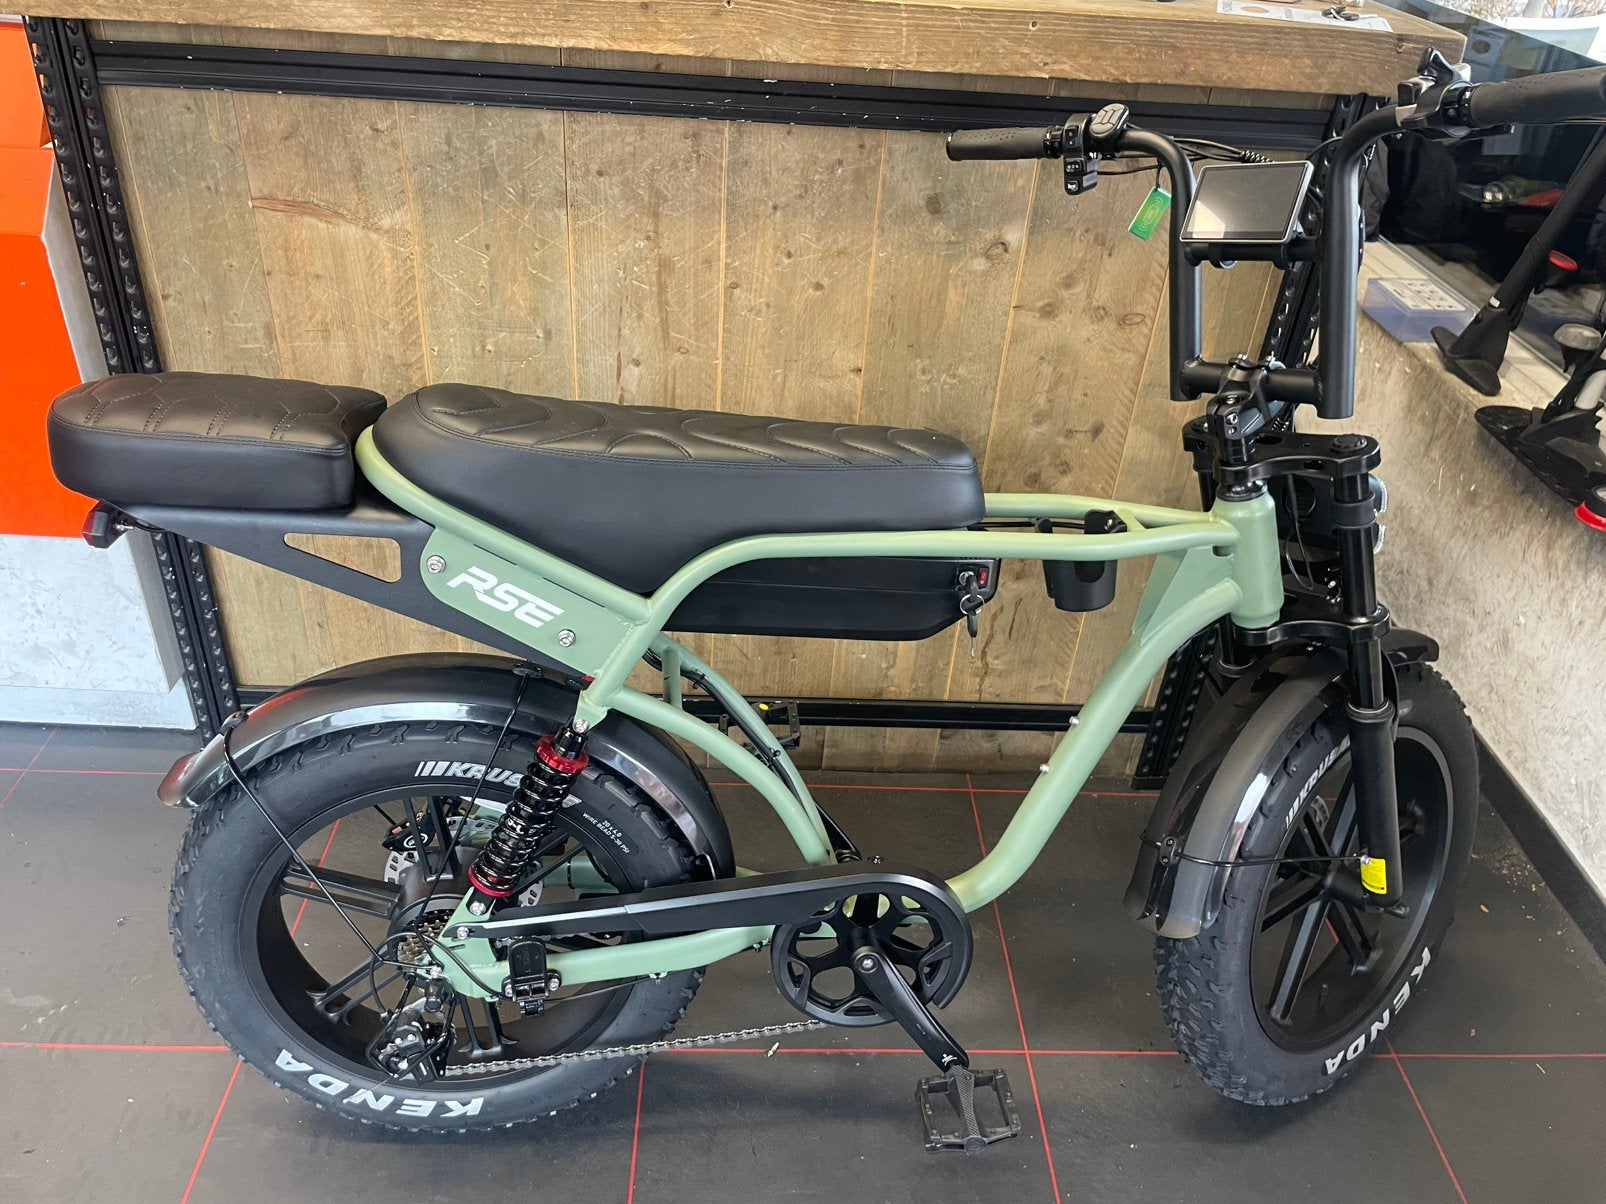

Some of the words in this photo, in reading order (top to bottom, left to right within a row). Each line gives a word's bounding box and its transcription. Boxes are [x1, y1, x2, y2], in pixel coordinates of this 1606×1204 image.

[446, 566, 565, 628] RSE
[583, 813, 598, 825] WIRE
[596, 823, 612, 836] BEAD
[1325, 946, 1431, 1075] KENDA
[275, 1049, 484, 1117] KENDA
